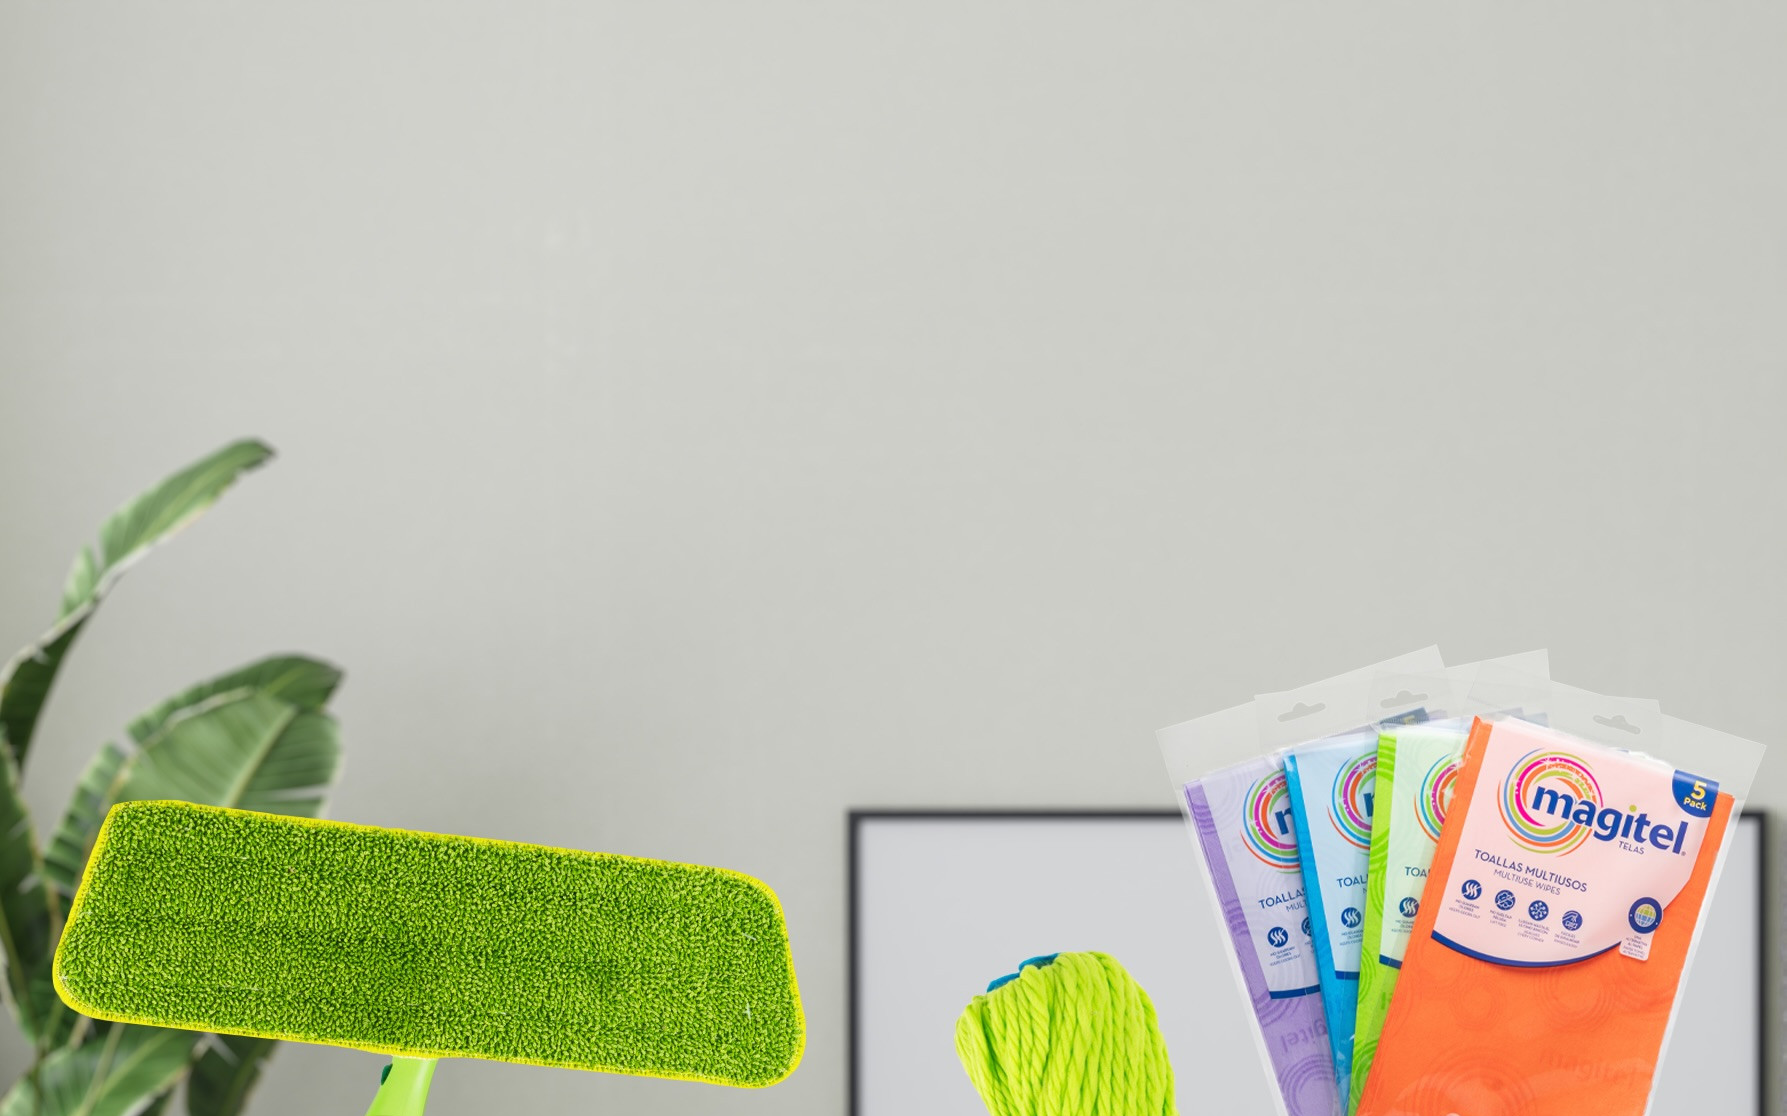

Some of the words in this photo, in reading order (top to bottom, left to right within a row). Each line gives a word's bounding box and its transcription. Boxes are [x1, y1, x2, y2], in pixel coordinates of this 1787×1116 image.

[1691, 780, 1707, 800] 5
[1683, 797, 1707, 811] Pack
[1531, 785, 1689, 855] magitel
[1618, 840, 1645, 855] TELAS
[1336, 873, 1369, 888] TOAL
[1474, 848, 1523, 872] TOALLAS
[1525, 865, 1588, 892] MULTIUSOS
[1493, 869, 1534, 888] MULTIUSE
[1535, 881, 1561, 896] WIPES
[1280, 1019, 1328, 1053] gitel
